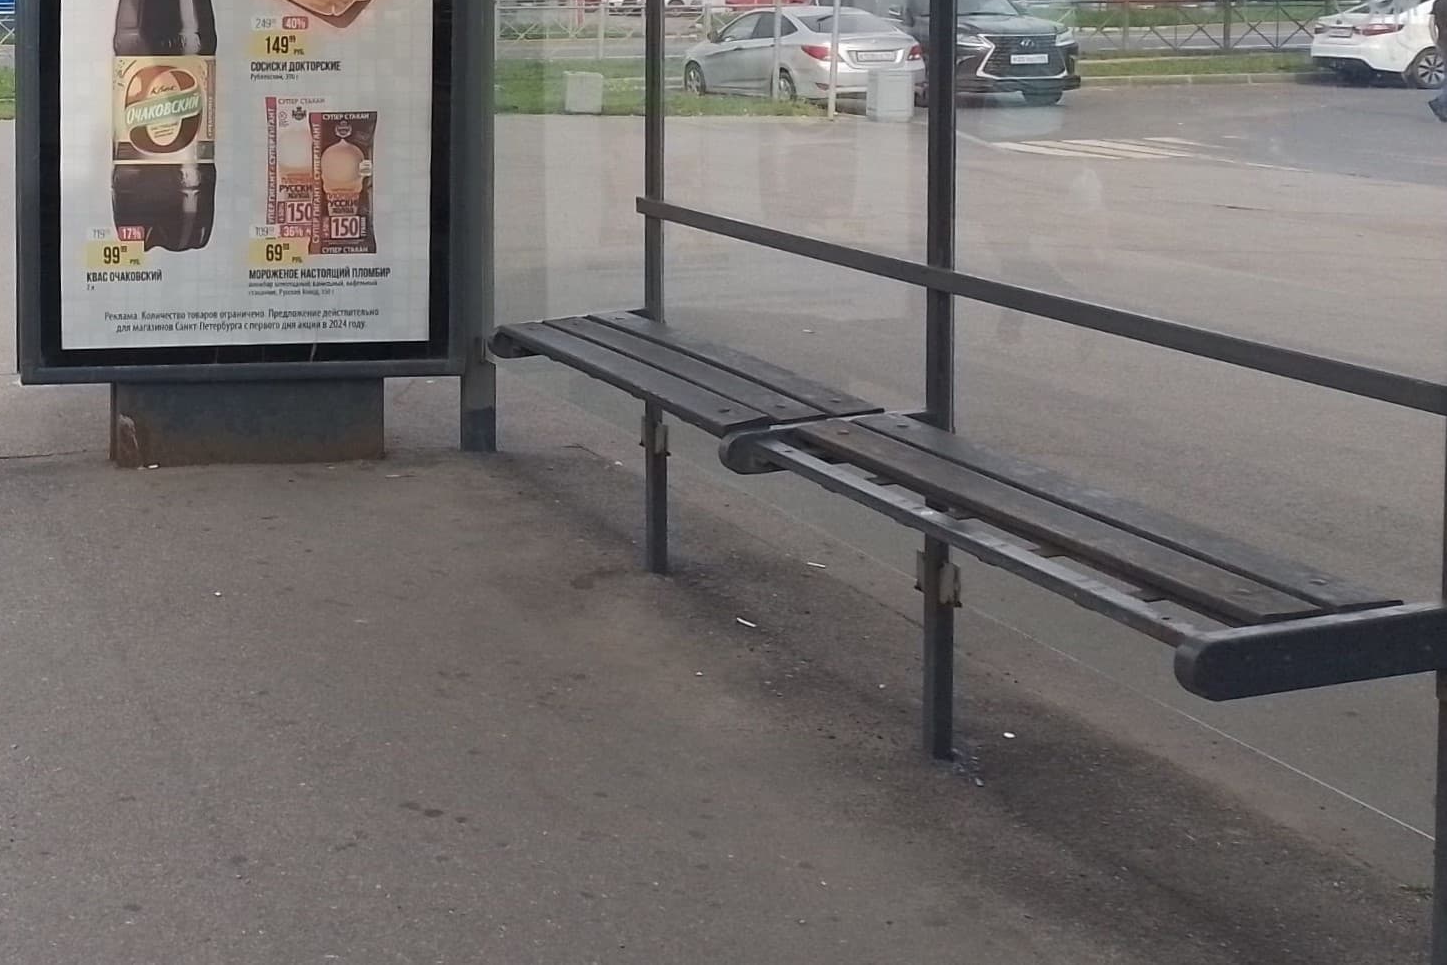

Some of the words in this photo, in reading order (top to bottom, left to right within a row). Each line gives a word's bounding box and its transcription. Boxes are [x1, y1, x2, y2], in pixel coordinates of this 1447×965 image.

[265, 36, 288, 54] 149
[250, 61, 288, 72] СОСИСКИ
[289, 61, 341, 72] ДОКТОРСКИЕ
[127, 93, 200, 125] ОЧАКОВСКИЙ
[288, 202, 313, 222] 150
[332, 217, 359, 237] 150
[103, 246, 120, 264] 99
[266, 243, 283, 261] 69
[86, 271, 108, 283] КВАС
[110, 269, 163, 283] ОЧАКОВСКИЙ
[249, 269, 299, 280] МОРОЖЕНОЕ
[300, 267, 351, 279] НАСТОЯЩИЙ
[352, 267, 391, 278] ПЛОМБИР
[141, 310, 186, 320] Количество
[188, 311, 218, 320] товаров
[268, 308, 321, 319] Предложение
[322, 308, 379, 318] действительно
[116, 324, 131, 333] для
[132, 323, 174, 332] магазинов
[250, 322, 281, 332] первого
[281, 321, 296, 330] дня
[297, 321, 321, 330] акции
[329, 319, 347, 330] 2024
[348, 320, 366, 331] году
